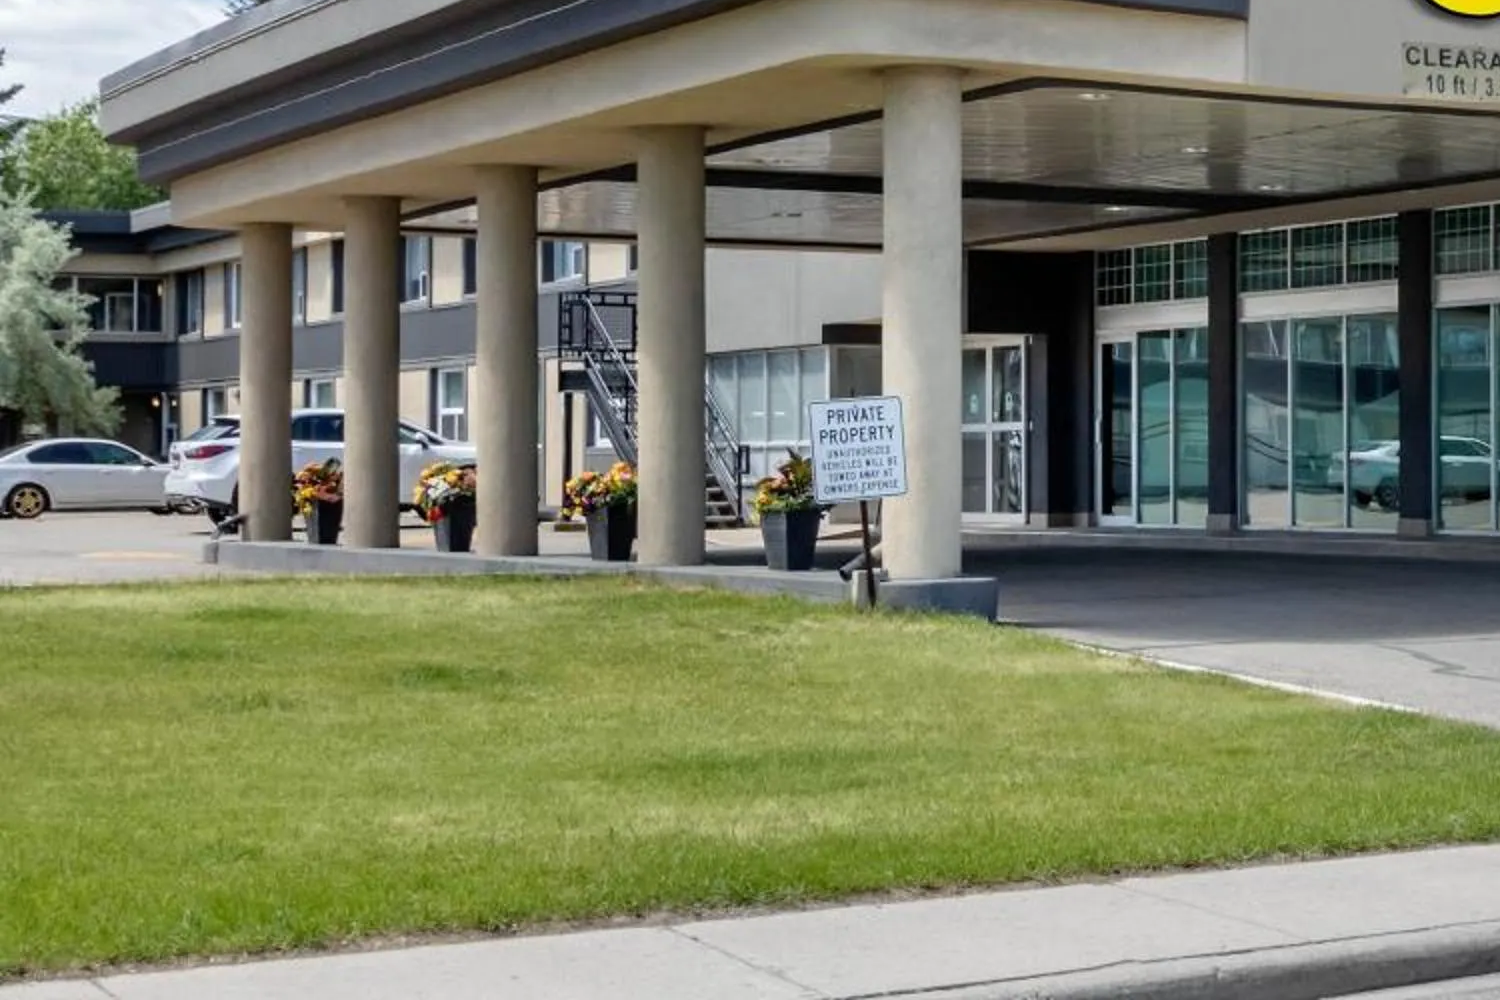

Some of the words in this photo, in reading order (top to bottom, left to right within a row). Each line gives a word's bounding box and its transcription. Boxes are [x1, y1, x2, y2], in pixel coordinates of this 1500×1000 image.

[1426, 74, 1445, 94] 10
[1453, 74, 1465, 95] ft
[827, 405, 885, 425] PRIVATE
[819, 424, 895, 445] PROPERTY
